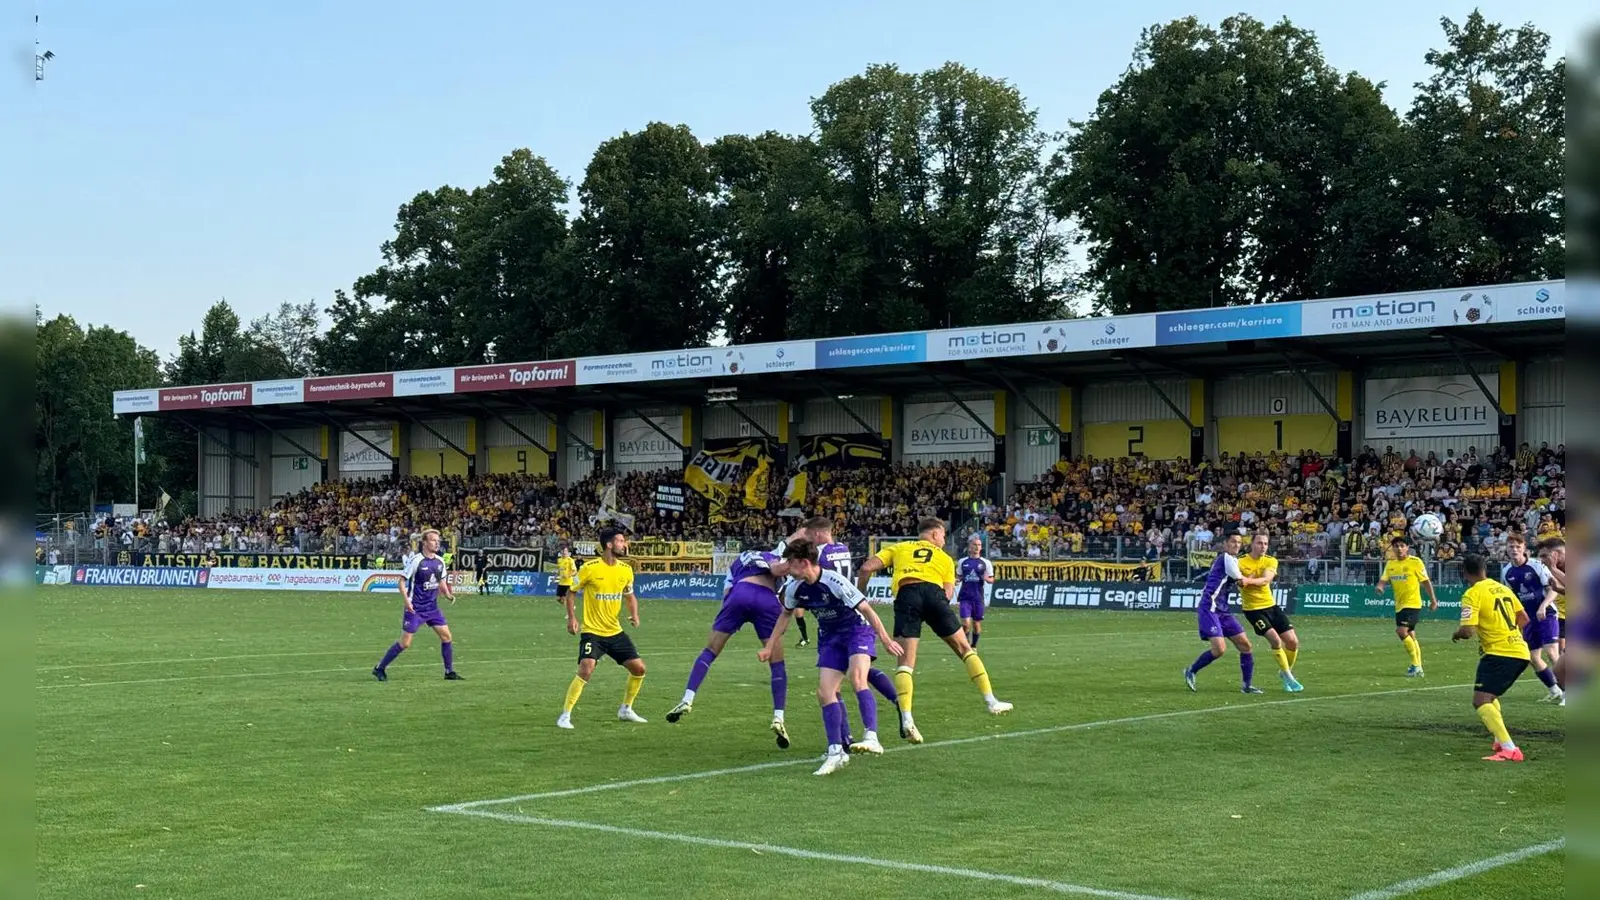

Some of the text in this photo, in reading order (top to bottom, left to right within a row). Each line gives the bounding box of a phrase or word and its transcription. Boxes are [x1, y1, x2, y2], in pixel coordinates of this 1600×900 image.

[1332, 300, 1436, 319] motion
[1517, 305, 1564, 315] schlaege
[1331, 315, 1436, 329] FOR MAN AND MACHINE
[949, 330, 1026, 347] motion
[1091, 335, 1130, 346] schlaeger
[651, 354, 712, 370] motion
[509, 365, 569, 385] Topform!
[200, 387, 247, 405] Topform!
[1273, 399, 1283, 412] 0
[1375, 405, 1488, 428] BAYREUTH
[1128, 426, 1144, 456] 2
[1273, 420, 1283, 450] 1
[619, 440, 677, 456] BAYREUT
[344, 450, 387, 463] BAYREU
[913, 548, 933, 564] 9
[670, 562, 710, 571] BAYRETH
[84, 568, 140, 584] FRANKEN
[139, 569, 198, 586] BRUNNEN
[210, 573, 264, 583] hagebaumarkt
[283, 573, 342, 585] hagebaumarkt
[672, 579, 687, 588] AM
[689, 577, 719, 588] BALL!
[994, 584, 1049, 604] capelli
[1104, 586, 1163, 607] capelli
[1227, 589, 1289, 606] calli
[1305, 593, 1350, 604] KURIER
[1255, 619, 1266, 630] 13
[584, 642, 592, 655] 5
